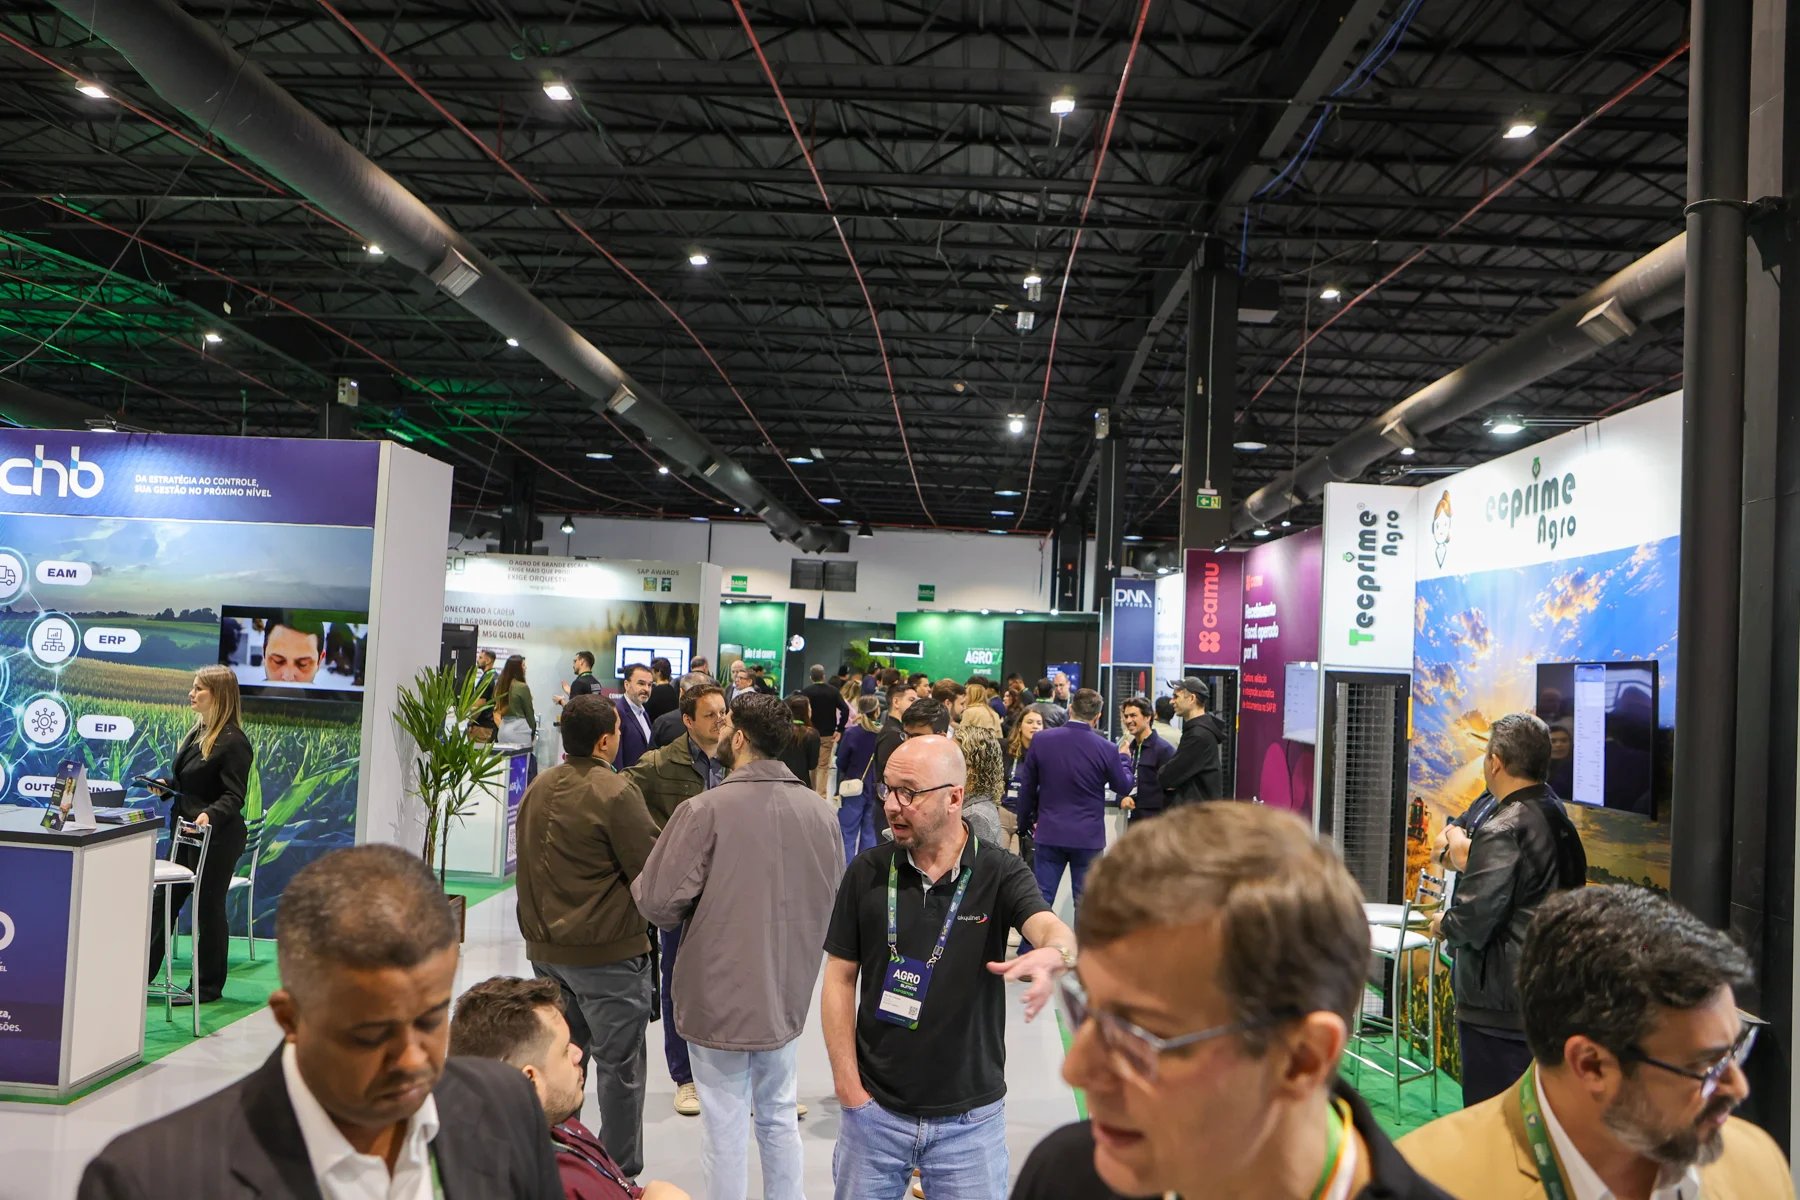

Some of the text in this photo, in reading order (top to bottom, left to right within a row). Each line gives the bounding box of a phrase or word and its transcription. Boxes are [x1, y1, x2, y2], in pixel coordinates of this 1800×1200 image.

[0, 444, 105, 498] chb
[135, 473, 260, 487] DA ESTRATÉGIA AO CONTROLE,
[134, 484, 272, 497] SUA GESTÃO NO PRÓXIMO NÍVEL
[1381, 509, 1404, 557] Agro
[1537, 514, 1577, 551] Agro
[47, 568, 77, 578] EAM
[651, 568, 680, 576] AWARDS
[507, 574, 528, 582] EXIGE
[1202, 562, 1220, 629] camu
[444, 605, 486, 614] ONECTANDO
[493, 608, 515, 616] CADEIA
[464, 617, 514, 628] AGRONEGÓCIO
[515, 620, 531, 628] COM
[482, 630, 526, 640] MSG GLOBAL
[1244, 621, 1280, 643] fiscal operado
[99, 635, 126, 645] ERP
[95, 723, 117, 733] EIP
[24, 782, 113, 793] OUTSCING
[893, 969, 921, 985] AGRO
[0, 1010, 11, 1019] za,
[0, 1021, 22, 1032] sões.
